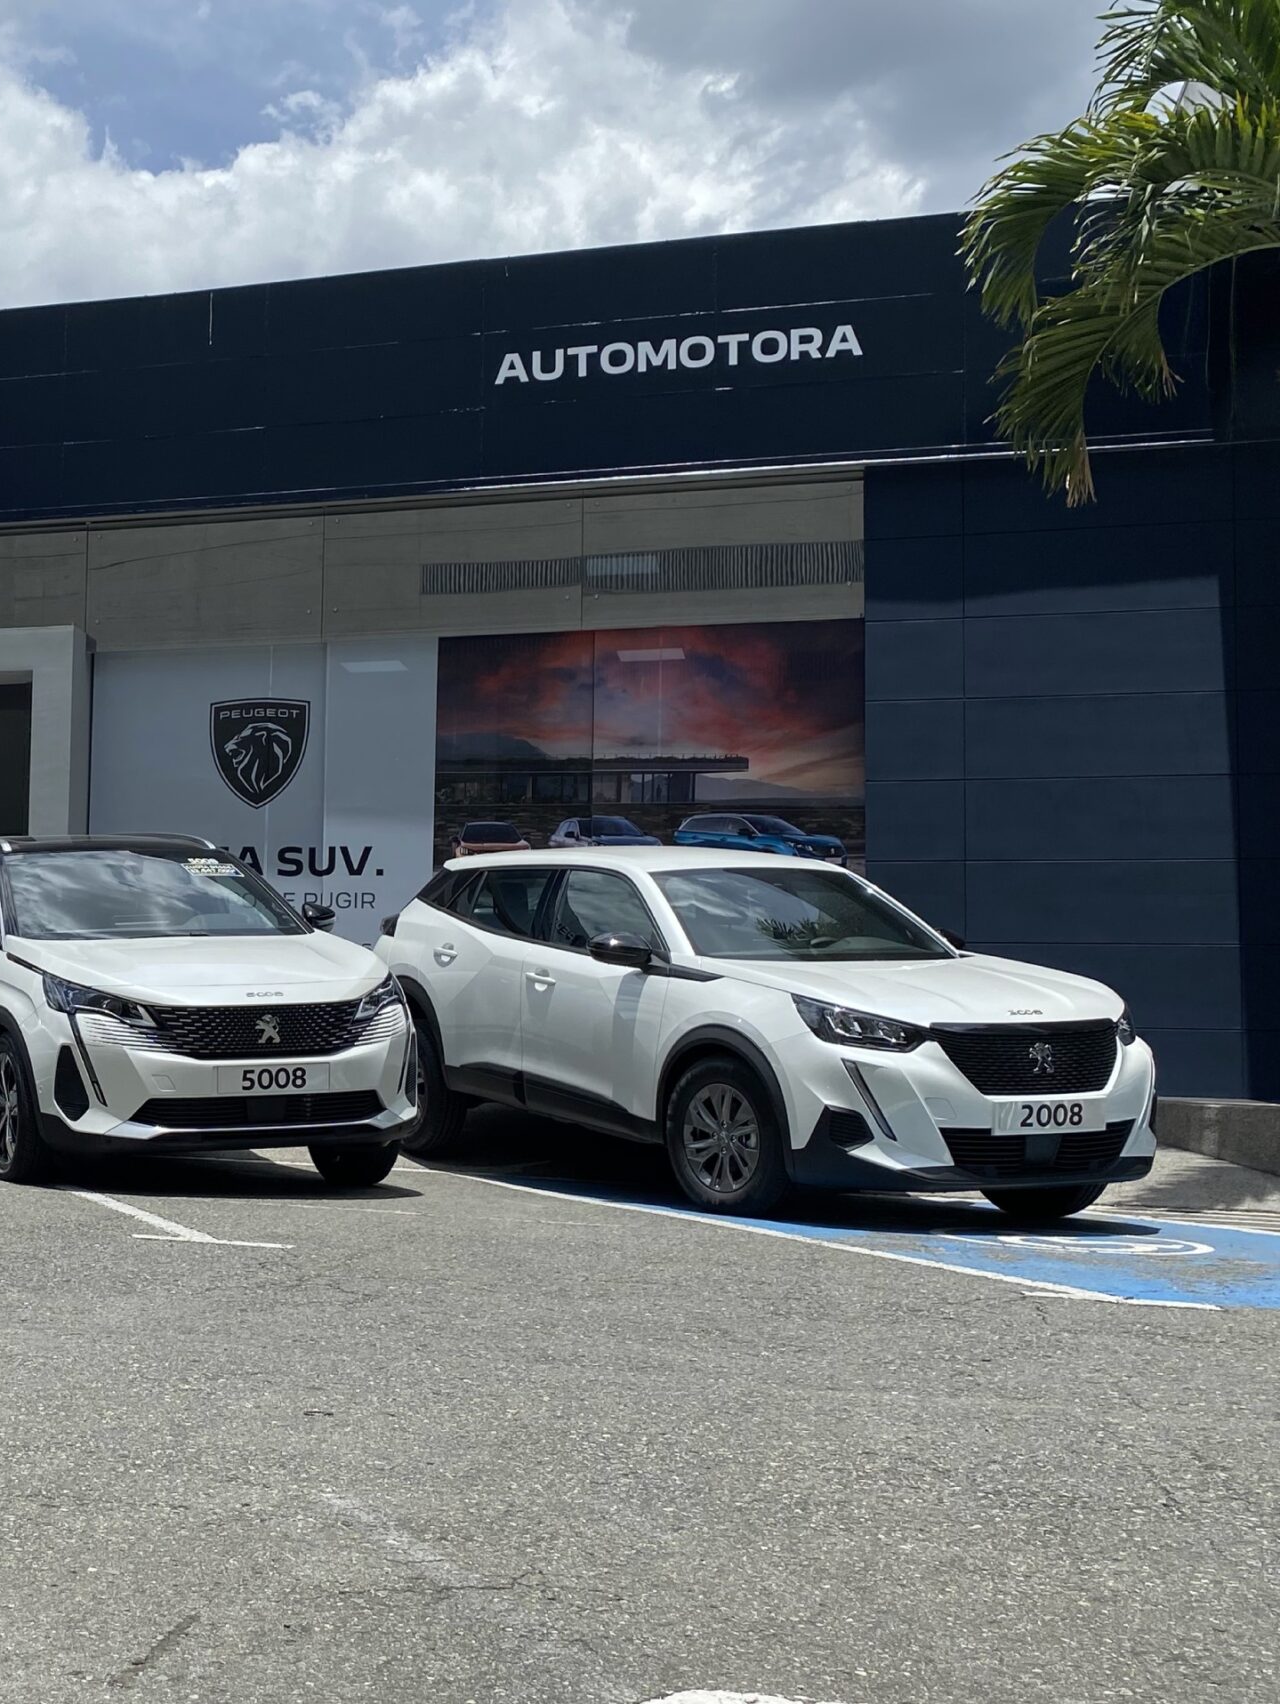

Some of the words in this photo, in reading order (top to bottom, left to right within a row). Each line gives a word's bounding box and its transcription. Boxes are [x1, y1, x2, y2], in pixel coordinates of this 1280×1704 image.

[494, 324, 864, 386] AUTOMOTORA
[220, 708, 300, 719] PEUGEOT
[277, 845, 384, 877] SUV.
[304, 892, 376, 909] RUGIR
[241, 1067, 307, 1091] 5008
[1020, 1103, 1084, 1128] 2008
